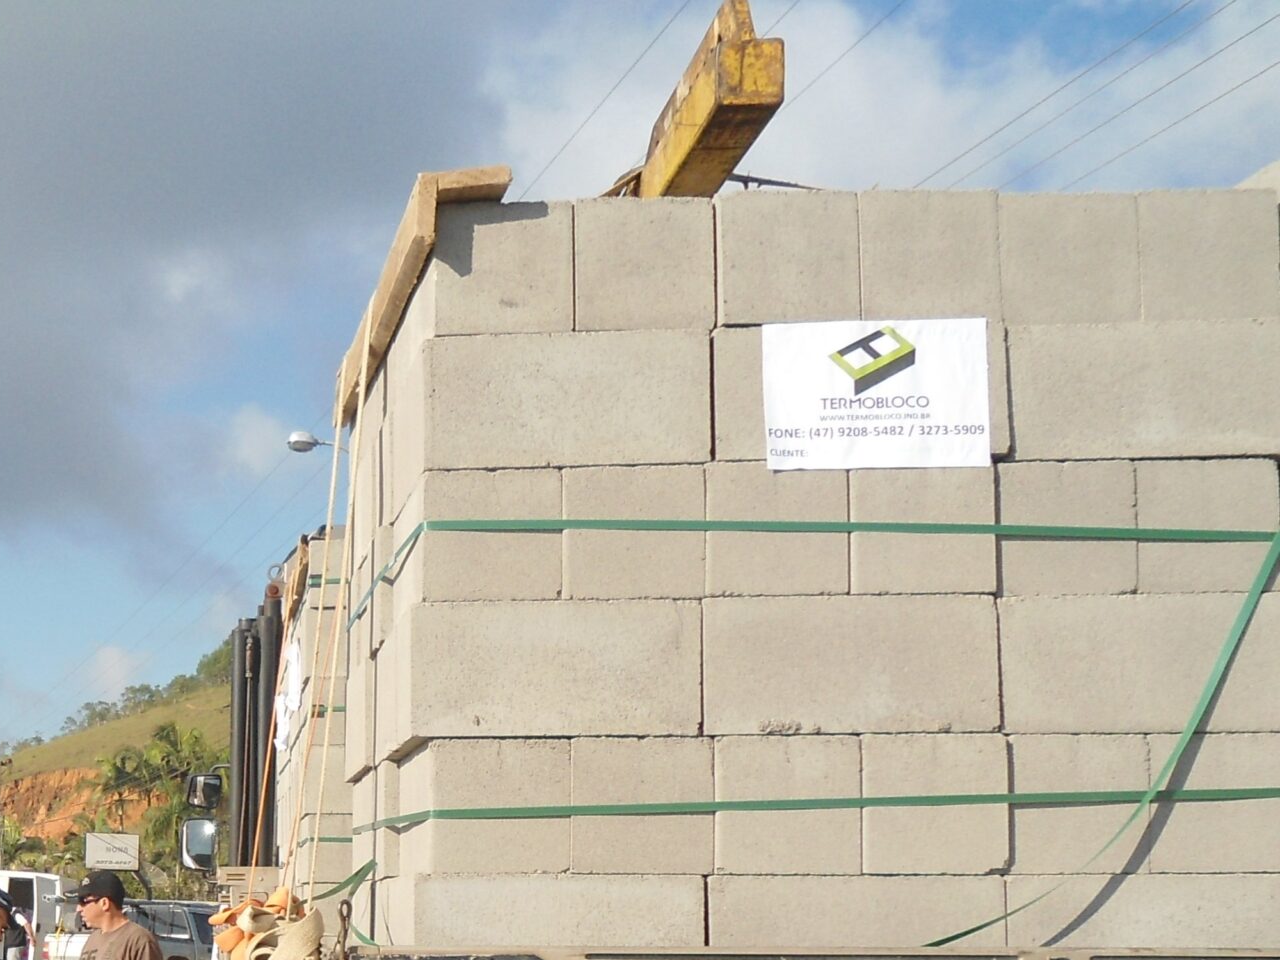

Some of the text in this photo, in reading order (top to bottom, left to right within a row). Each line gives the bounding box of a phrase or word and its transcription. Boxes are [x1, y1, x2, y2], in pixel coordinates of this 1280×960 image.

[821, 395, 930, 411] TERMOBLOCO
[768, 424, 985, 440] FONE: (47) 9208-5482 / 3273-5909
[770, 448, 809, 458] CLIENTE:
